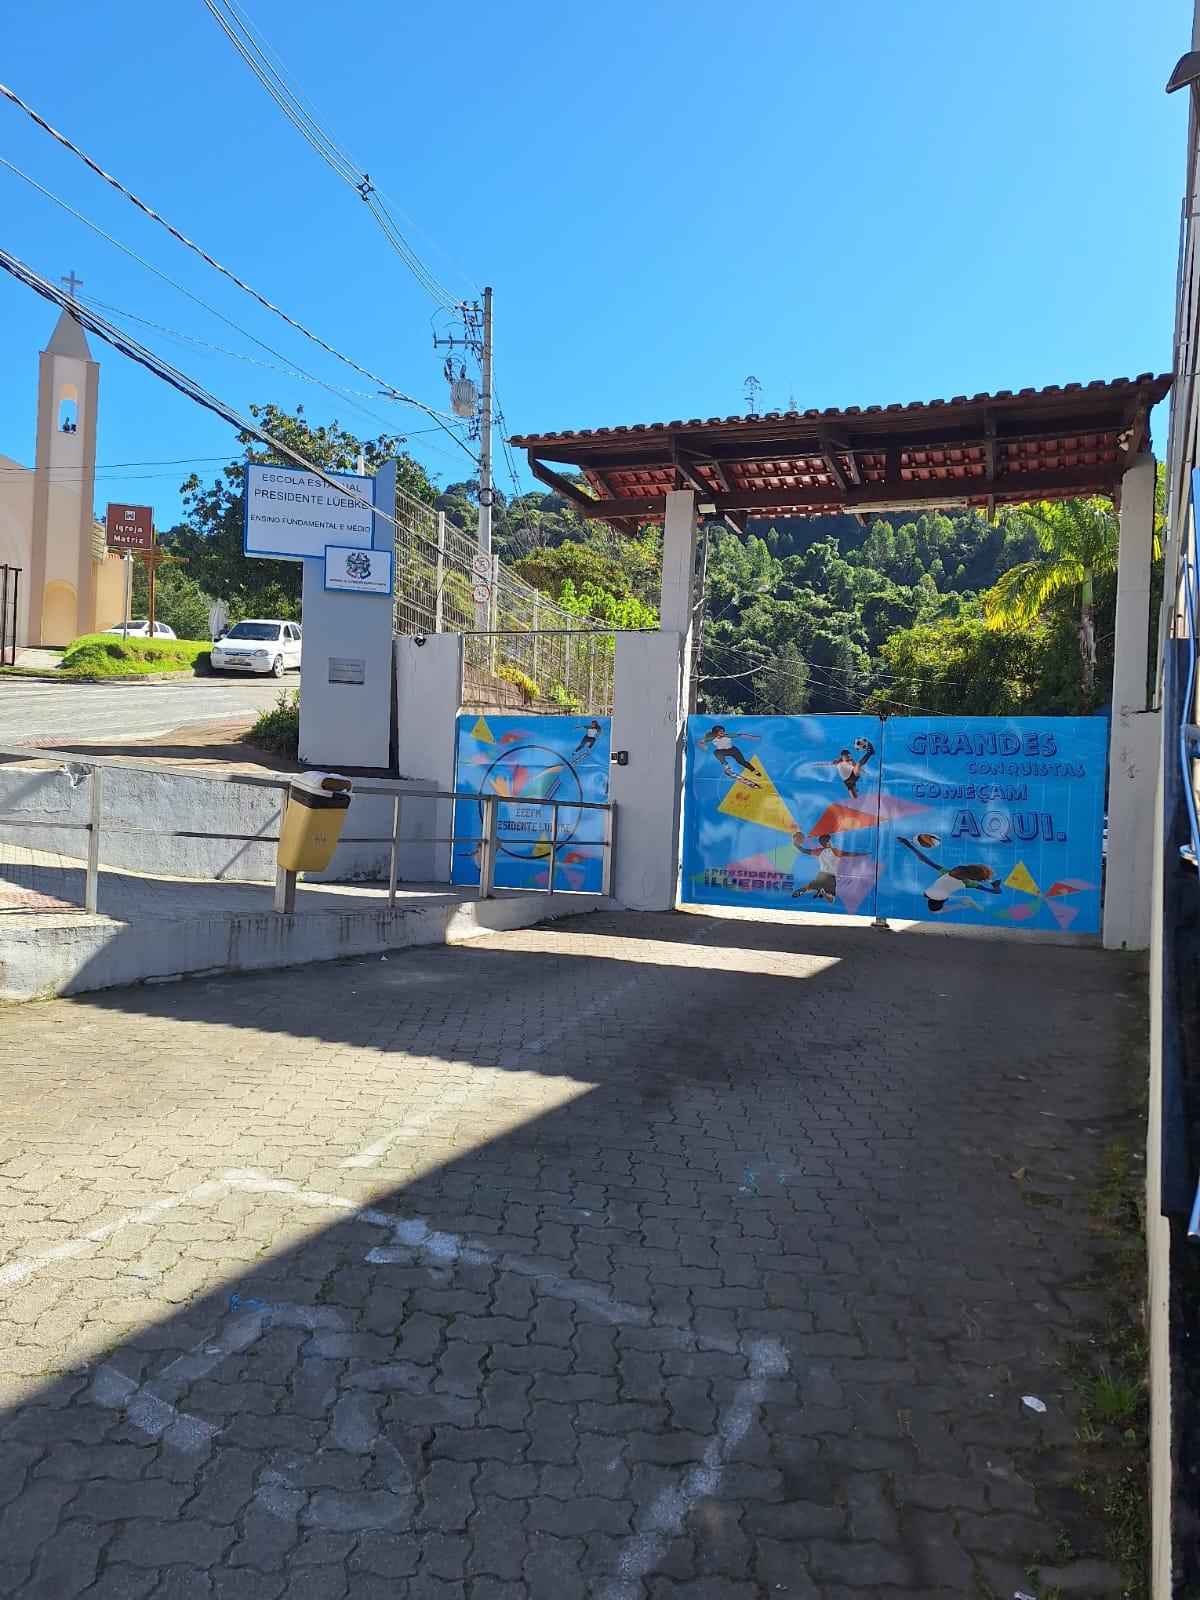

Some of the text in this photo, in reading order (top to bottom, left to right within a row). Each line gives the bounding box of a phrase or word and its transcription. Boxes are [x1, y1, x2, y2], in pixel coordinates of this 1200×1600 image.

[262, 473, 305, 487] ESCOLA
[254, 488, 324, 505] PRESIDENTE
[115, 523, 143, 534] Igreja
[250, 513, 371, 534] ENSINO FUNDAMENTAL E MÉDIO
[113, 534, 145, 545] Matriz
[907, 732, 1058, 758] GRANDES
[966, 761, 1086, 778] CONQUISTAS
[911, 783, 1028, 804] COMEÇAM
[951, 809, 1067, 843] AQUI.
[711, 868, 795, 880] PRESIDENTE
[711, 876, 795, 892] LUEBKE
